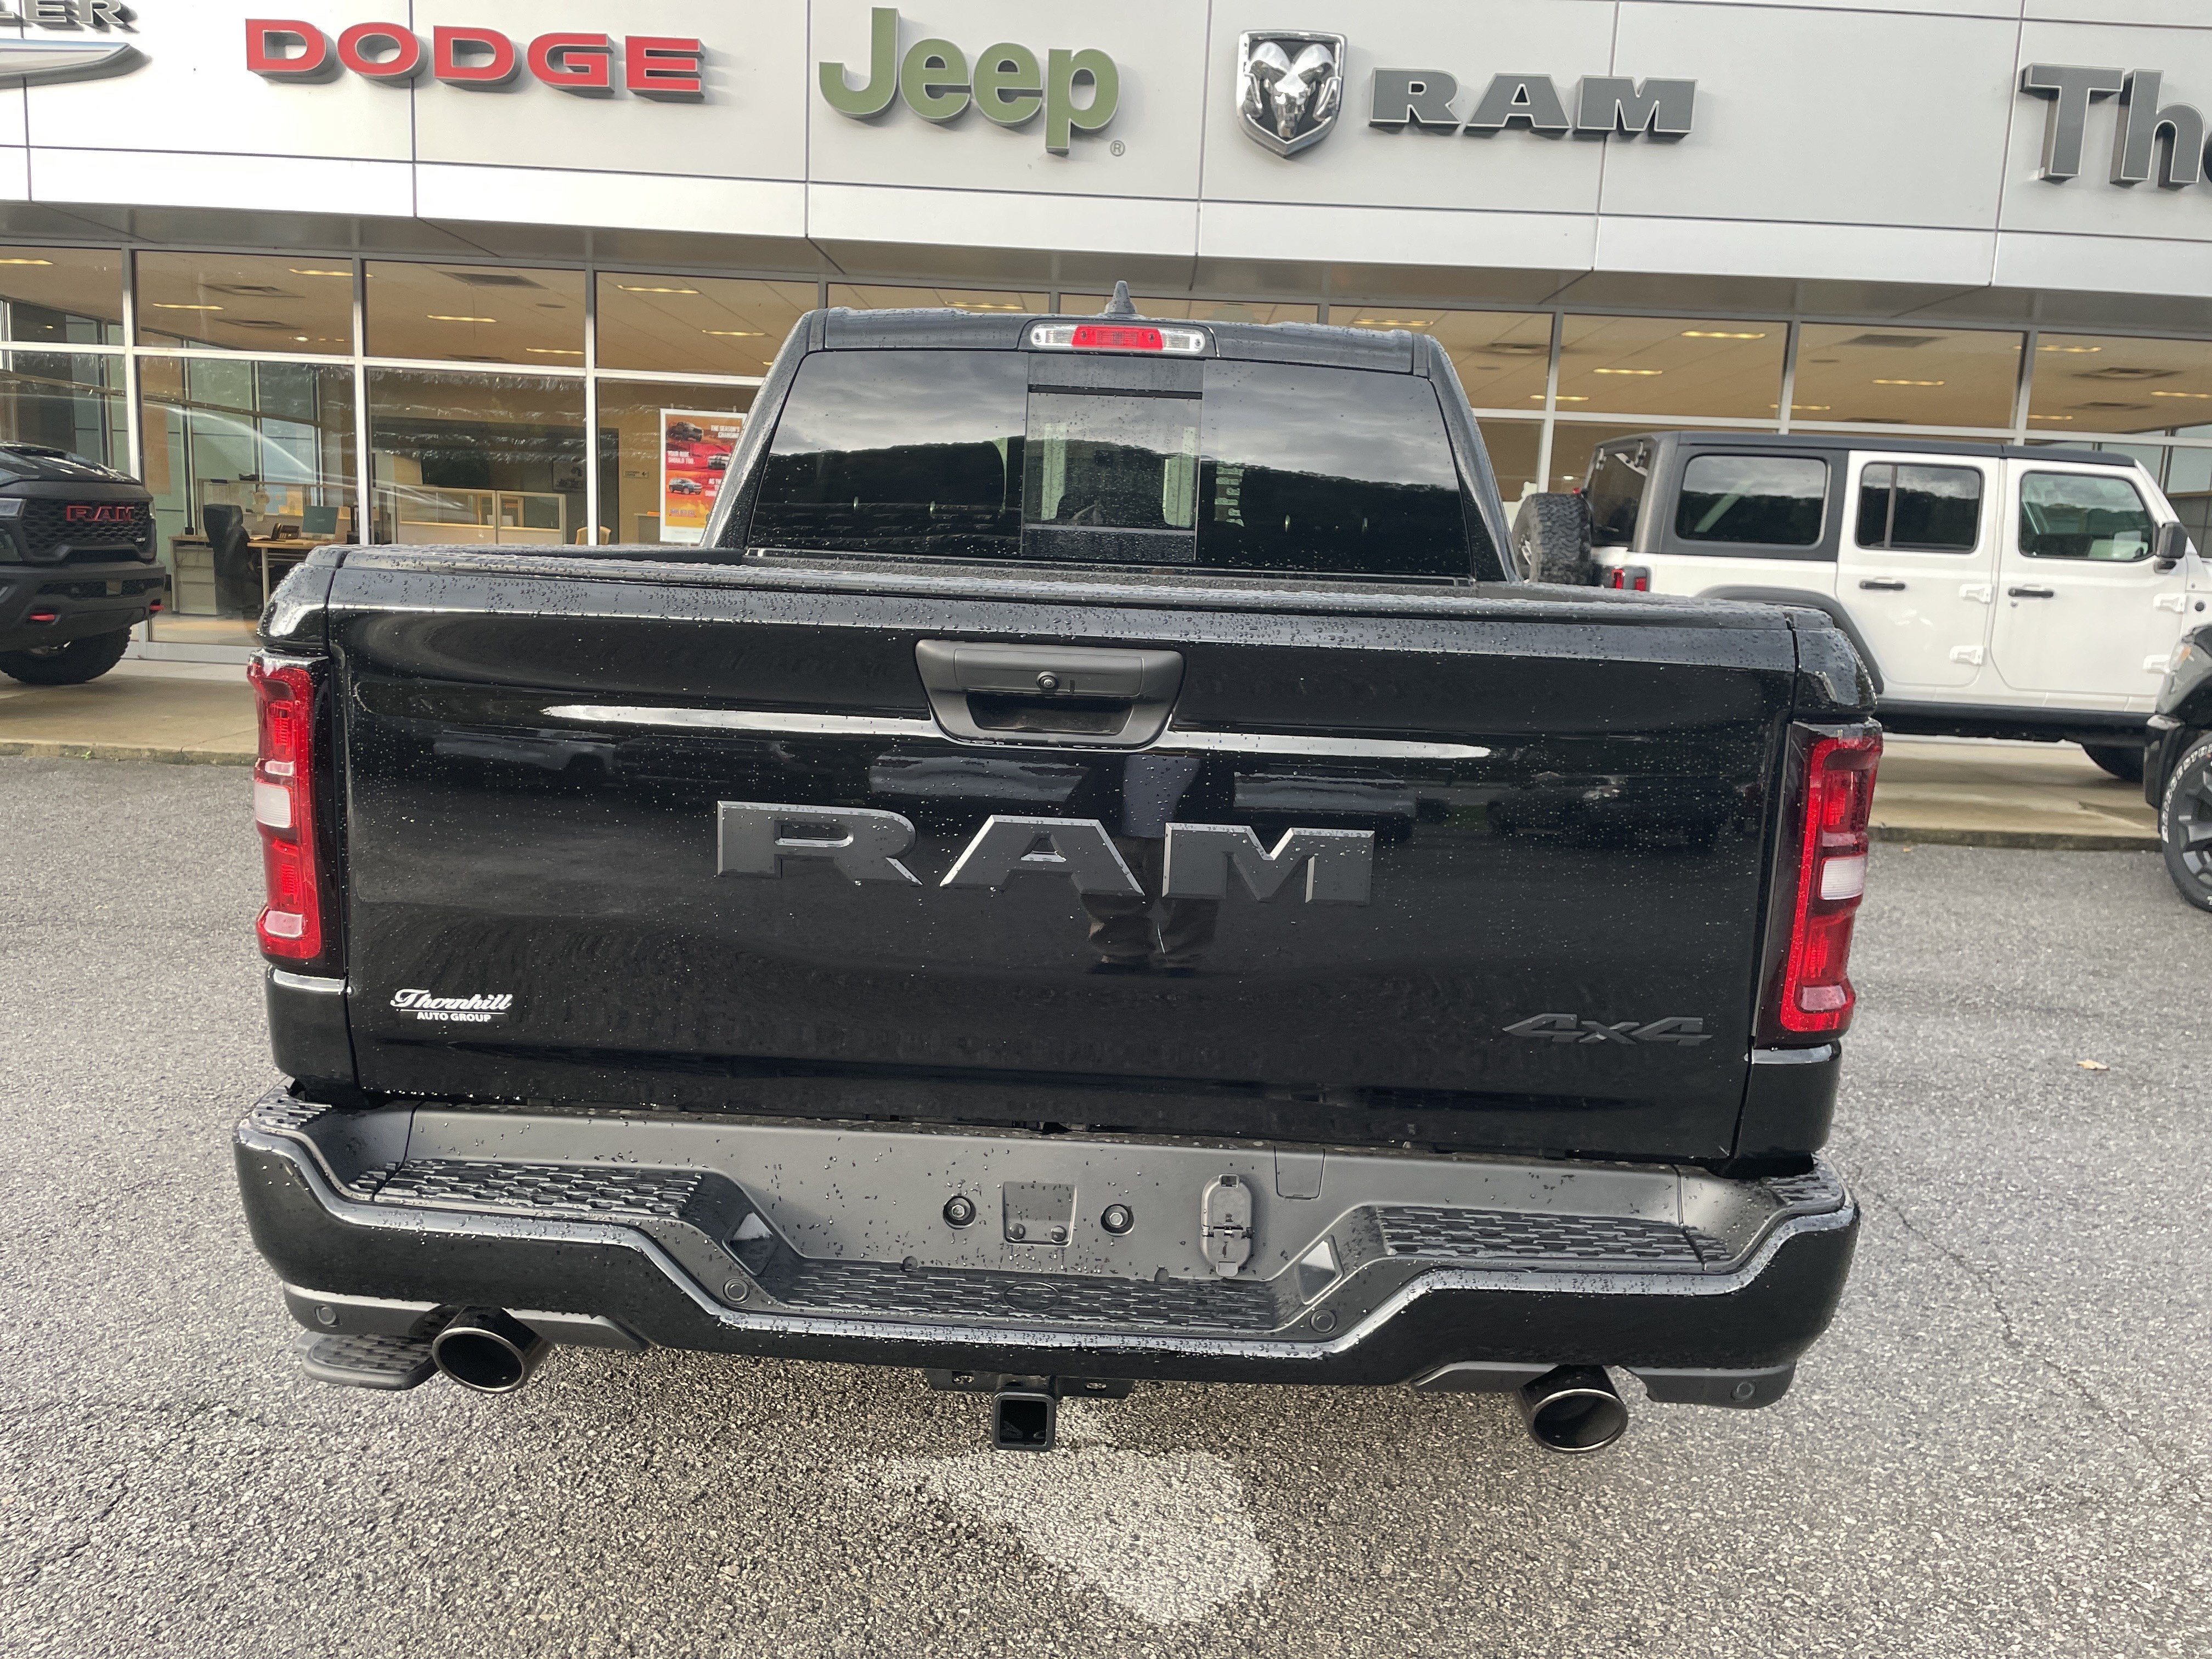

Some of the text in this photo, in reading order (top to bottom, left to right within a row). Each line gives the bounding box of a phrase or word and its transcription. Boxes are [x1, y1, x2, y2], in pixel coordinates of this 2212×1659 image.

[0, 0, 125, 24] ER
[245, 18, 704, 100] DODGE
[819, 7, 1120, 154] Jeep
[1369, 67, 1699, 139] RAM
[2020, 62, 2212, 189] Th
[65, 505, 135, 522] RAM
[717, 800, 1375, 906] RAM
[390, 989, 513, 1010] Thornhill
[416, 1012, 492, 1022] AUTO GROUP
[1502, 1013, 1713, 1047] 4x4
